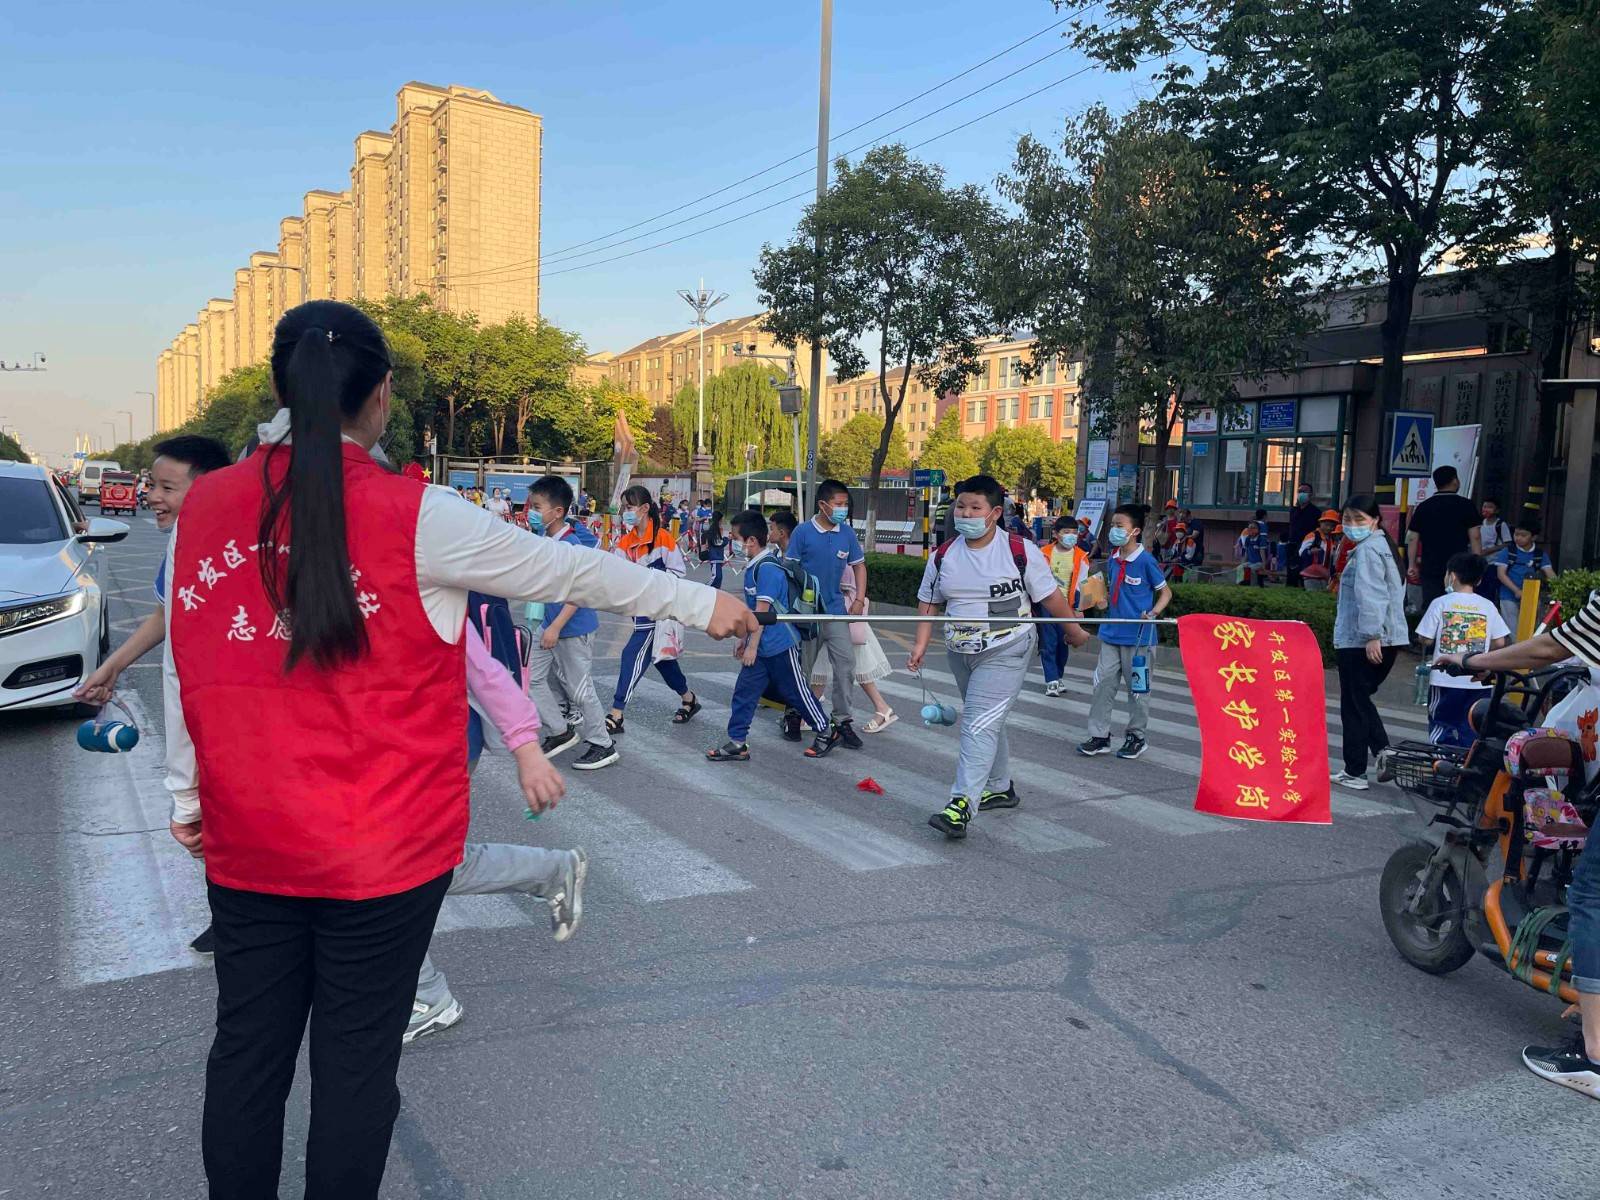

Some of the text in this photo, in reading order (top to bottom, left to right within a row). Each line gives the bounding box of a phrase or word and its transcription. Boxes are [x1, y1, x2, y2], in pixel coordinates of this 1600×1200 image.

[1213, 621, 1270, 810] 家长护学岗
[1267, 631, 1303, 805] 开发区第一实验小学
